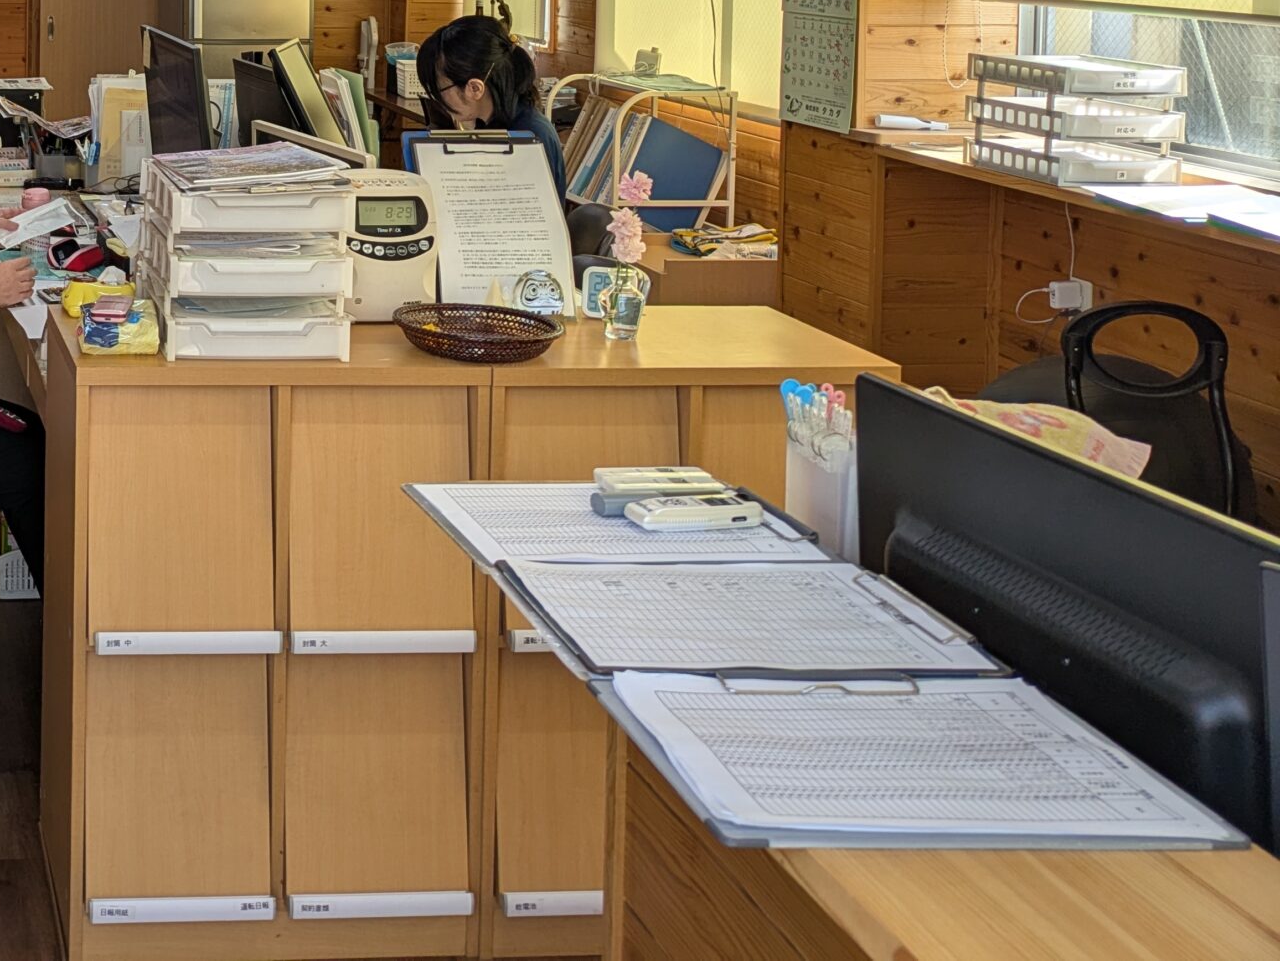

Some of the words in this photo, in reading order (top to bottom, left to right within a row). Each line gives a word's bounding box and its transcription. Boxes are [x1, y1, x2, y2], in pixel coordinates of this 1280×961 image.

[385, 206, 413, 219] 8:29
[124, 639, 132, 647] 中
[319, 639, 329, 648] 大
